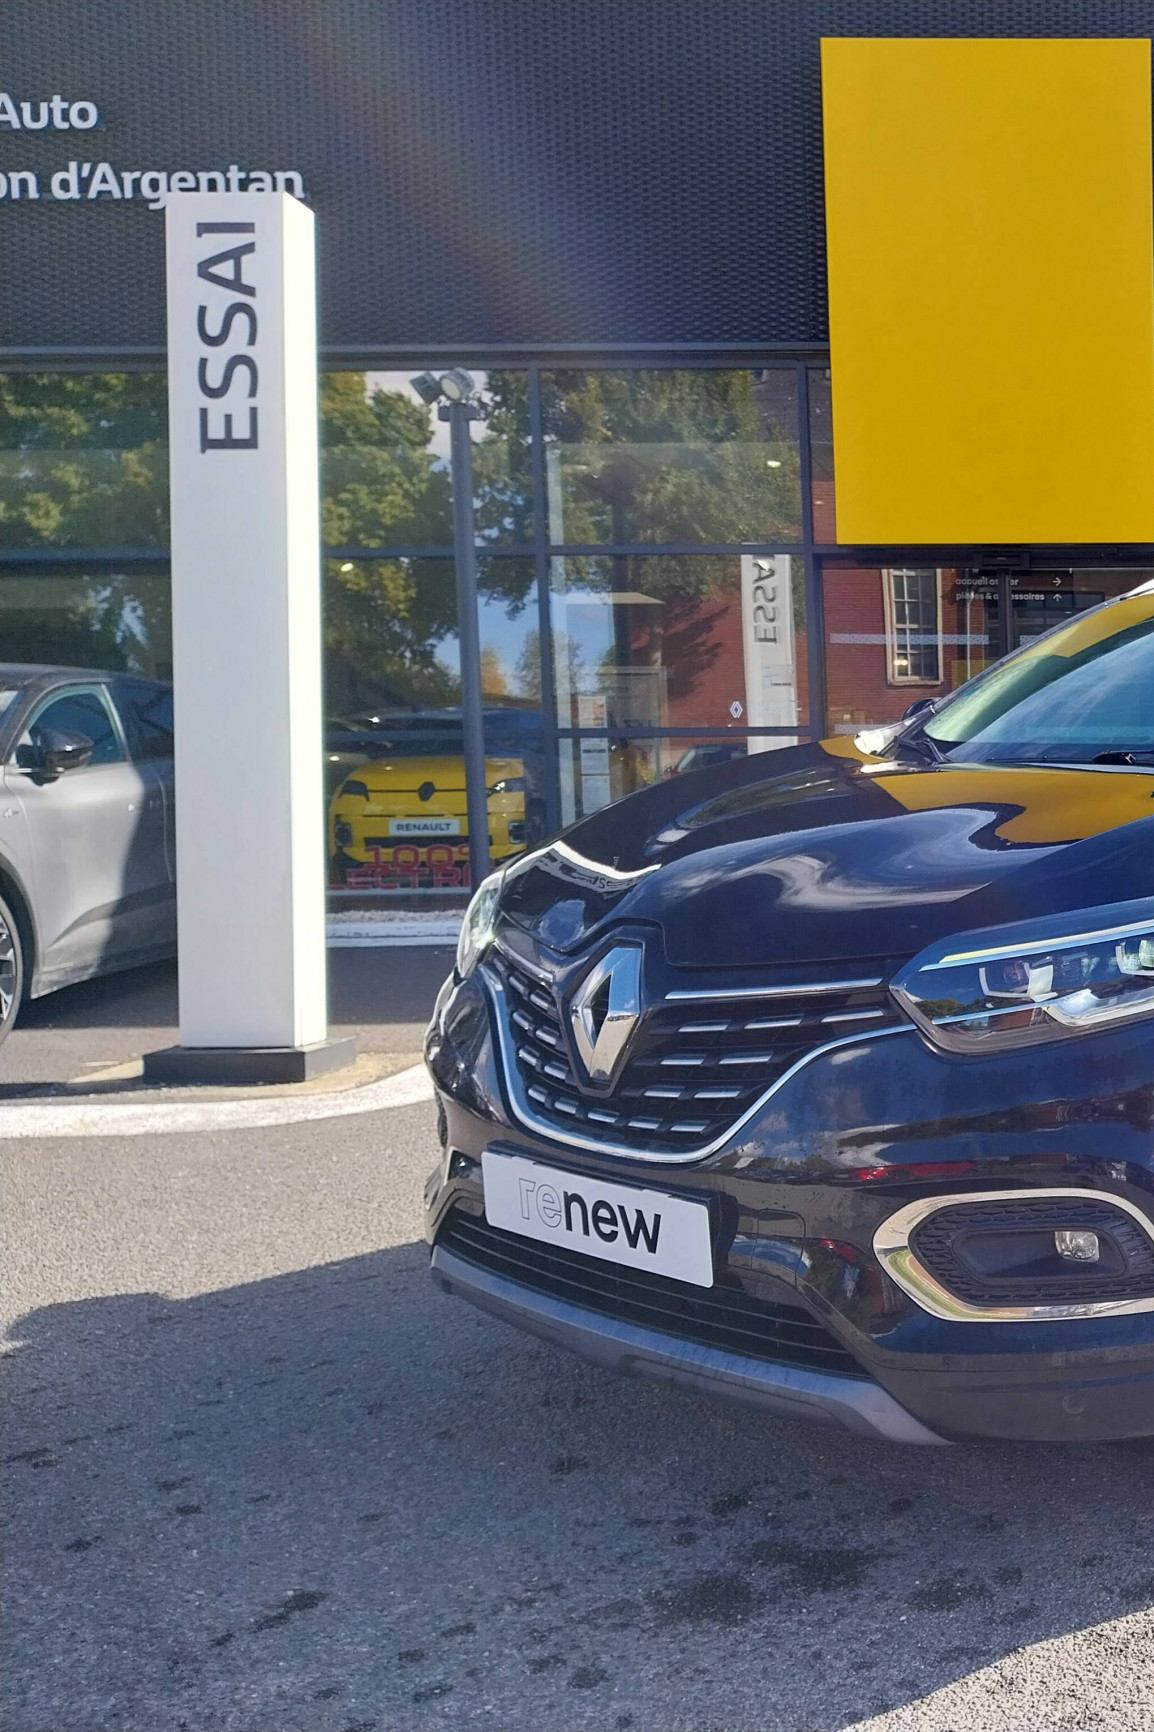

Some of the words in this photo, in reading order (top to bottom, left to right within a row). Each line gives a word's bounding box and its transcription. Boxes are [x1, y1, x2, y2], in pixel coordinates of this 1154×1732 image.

[0, 93, 98, 129] Auto
[51, 161, 305, 210] d'Argentan
[196, 222, 258, 453] ESSAI
[956, 577, 988, 585] accueil
[989, 577, 1019, 585] ater
[985, 592, 992, 600] &
[396, 822, 452, 832] RENAULT
[518, 1177, 662, 1254] renew
